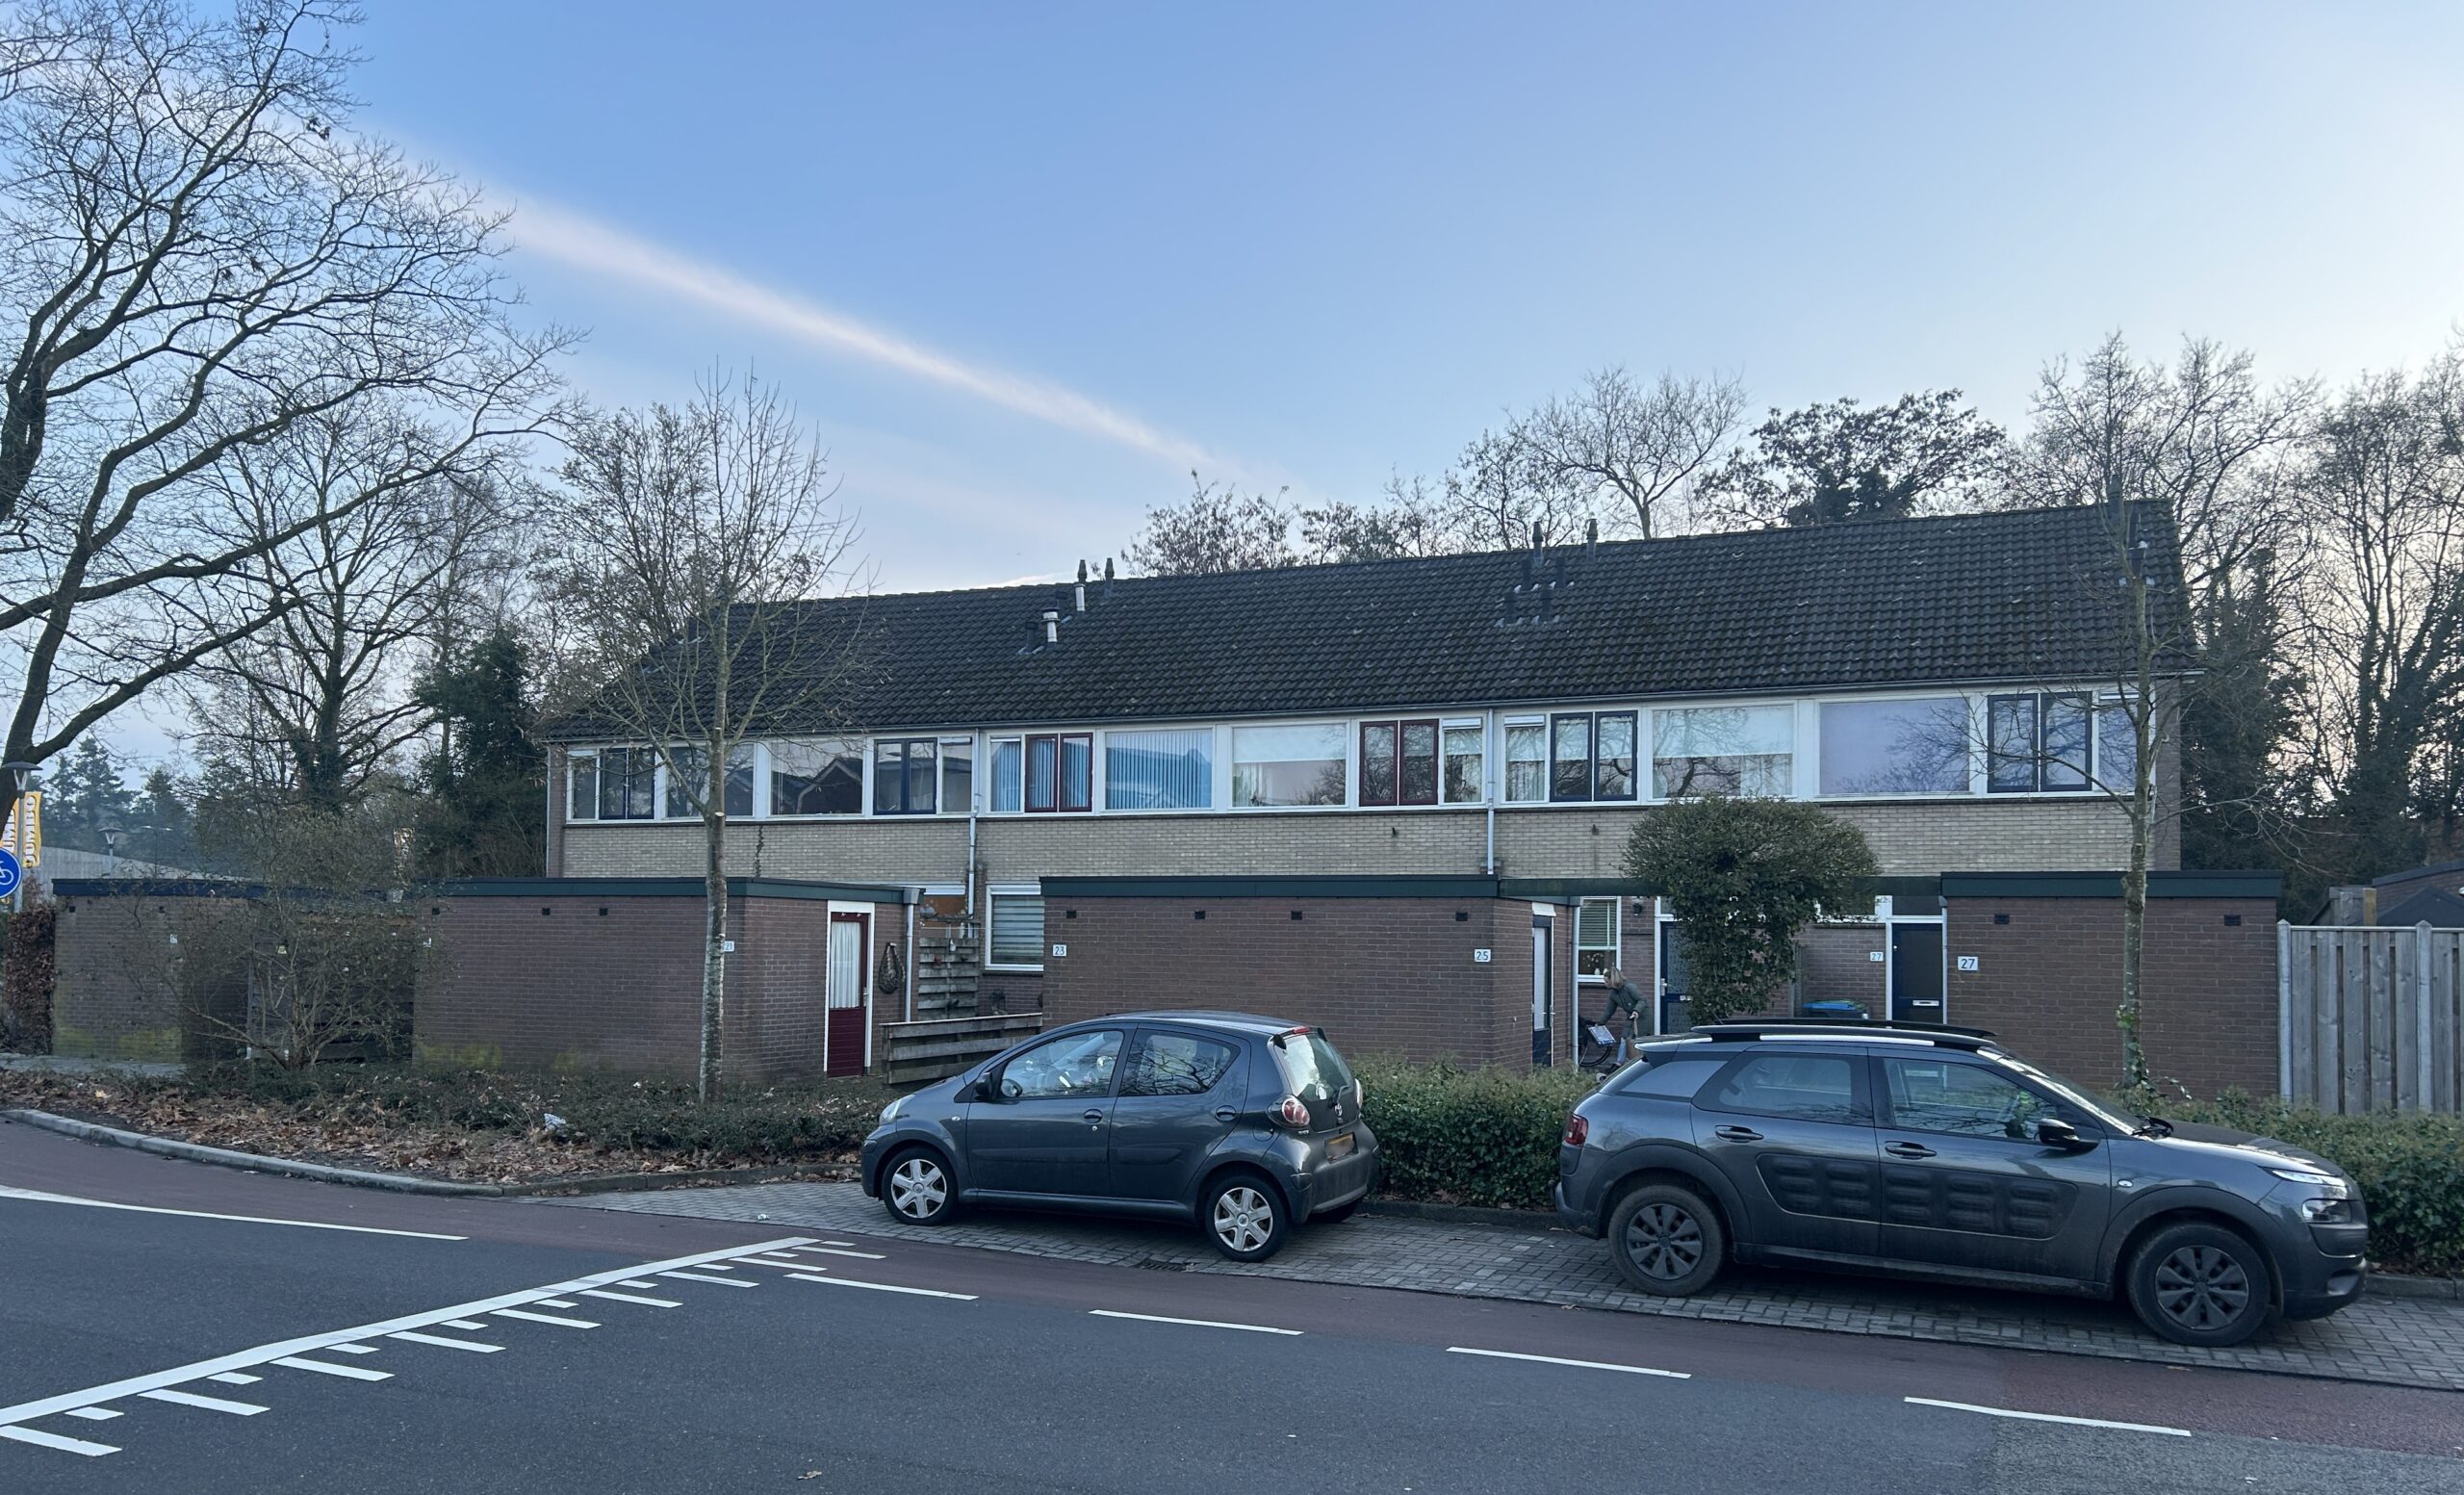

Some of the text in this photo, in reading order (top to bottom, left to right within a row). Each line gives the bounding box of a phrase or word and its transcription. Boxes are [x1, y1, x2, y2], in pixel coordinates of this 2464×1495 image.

[25, 795, 37, 863] JUMBO
[1055, 945, 1065, 956] 23
[1476, 950, 1489, 961] 25
[1871, 952, 1882, 961] 27
[1961, 958, 1976, 969] 27
